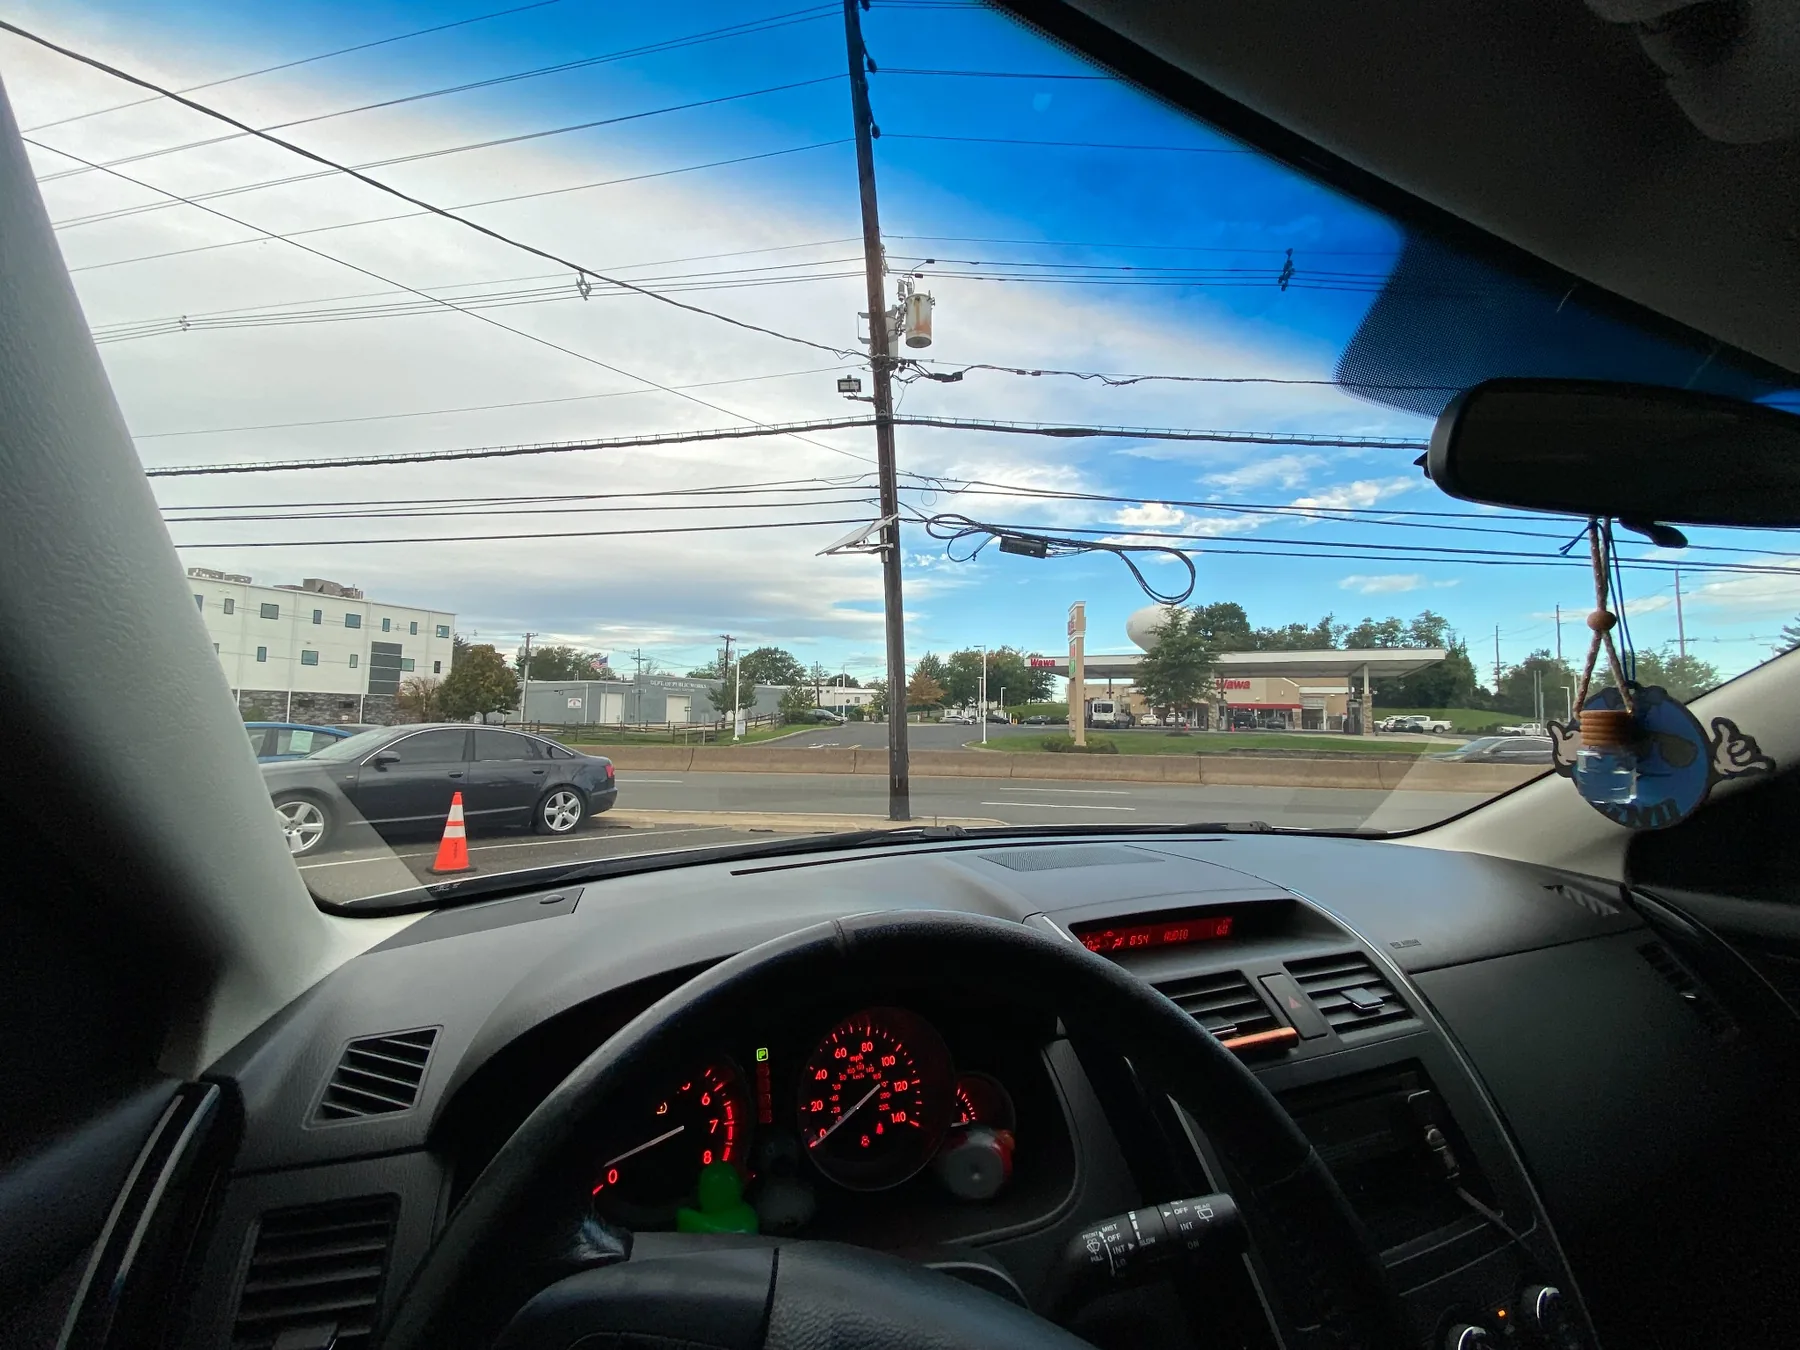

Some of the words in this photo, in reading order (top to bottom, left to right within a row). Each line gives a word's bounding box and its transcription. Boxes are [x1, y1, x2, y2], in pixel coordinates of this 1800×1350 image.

[1030, 658, 1056, 666] Wawa
[1216, 680, 1250, 690] Wawa
[862, 1042, 873, 1052] 80
[834, 1048, 847, 1058] 60
[850, 1052, 863, 1062] mph
[882, 1055, 896, 1066] 100
[815, 1069, 827, 1080] 40
[894, 1080, 908, 1092] 120
[702, 1092, 710, 1106] 6
[811, 1100, 823, 1112] 20
[891, 1112, 906, 1124] 140
[710, 1119, 718, 1133] 7
[820, 1128, 826, 1138] 0
[703, 1150, 712, 1164] 8
[608, 1169, 618, 1184] 0
[1102, 1223, 1117, 1232] MIST
[1180, 1222, 1193, 1231] INT
[1082, 1231, 1098, 1240] FRONT
[1107, 1232, 1120, 1242] OFF
[1140, 1236, 1156, 1246] SLOW
[1188, 1240, 1200, 1250] ON
[1112, 1244, 1125, 1255] INT
